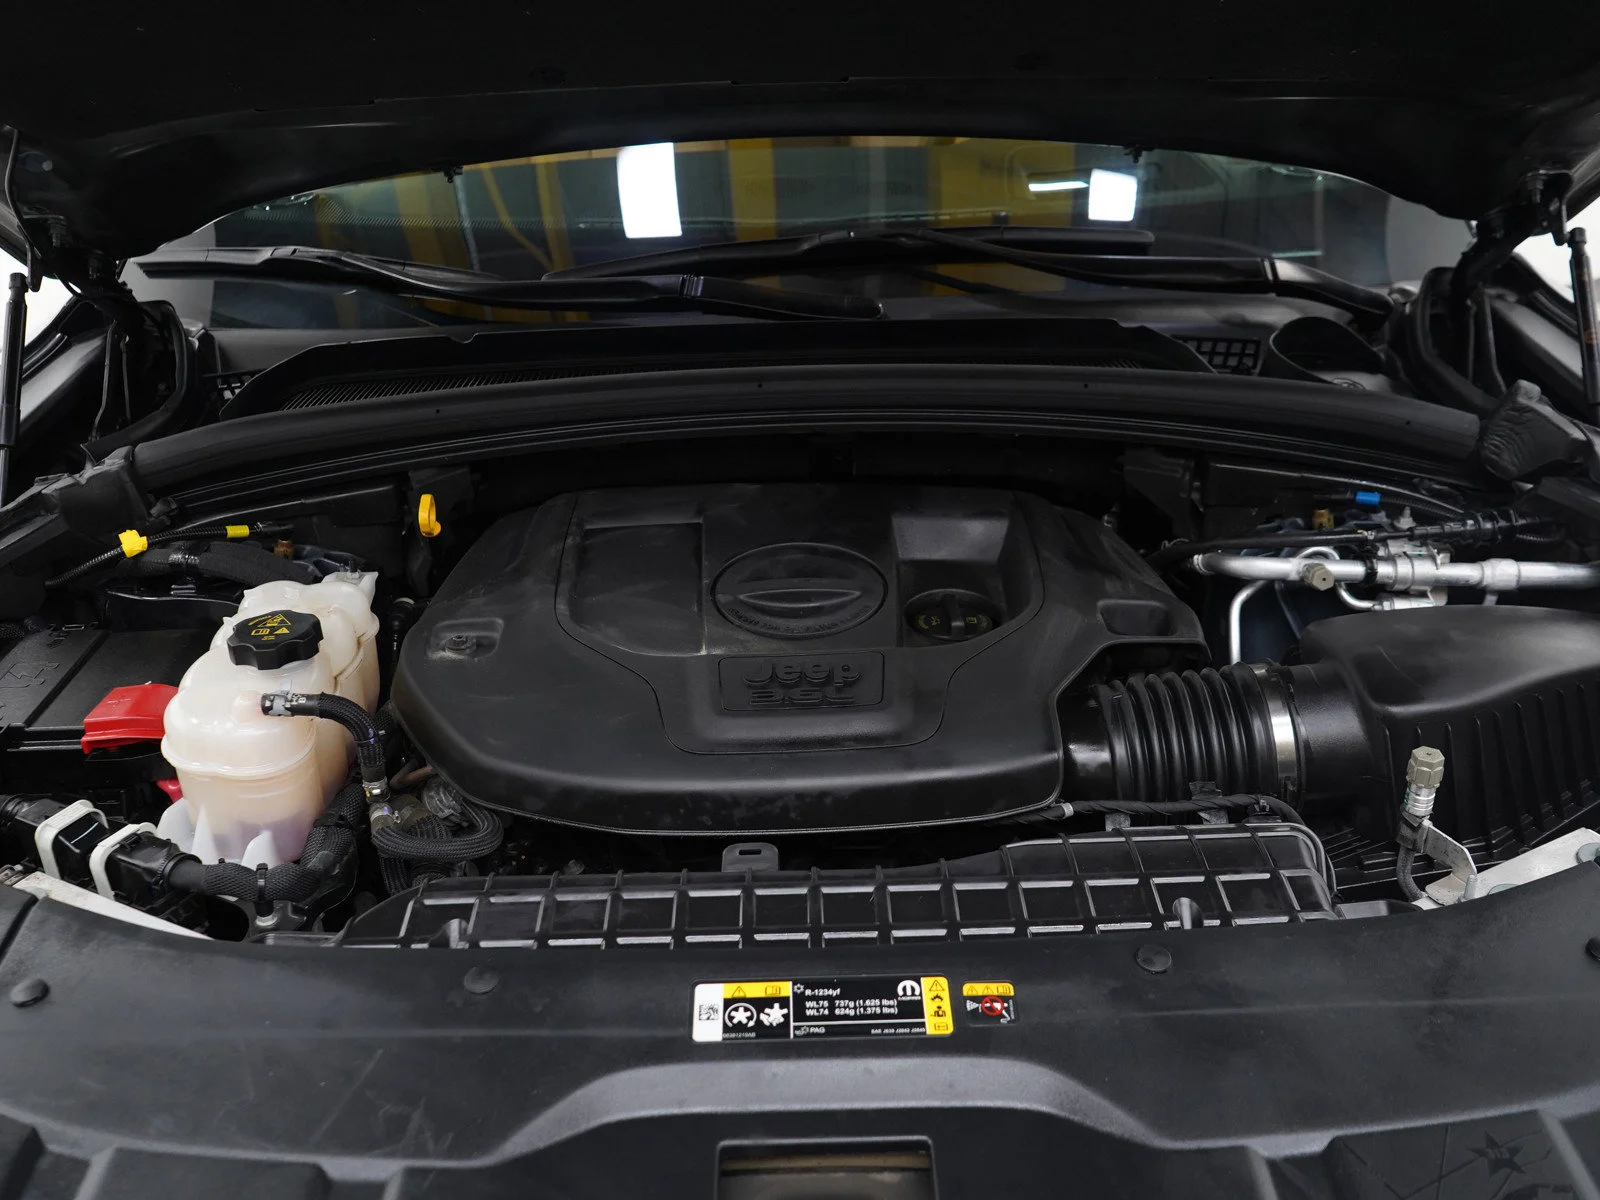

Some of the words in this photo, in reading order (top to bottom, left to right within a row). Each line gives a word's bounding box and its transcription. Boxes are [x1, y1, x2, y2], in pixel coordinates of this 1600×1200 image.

[742, 658, 864, 687] Jeep
[748, 688, 855, 706] 3.6L
[805, 988, 841, 997] R-1234yf
[805, 1000, 829, 1008] WL75
[835, 1000, 855, 1008] 737g
[856, 999, 880, 1008] (1.625
[882, 998, 897, 1007] lbs)
[805, 1008, 829, 1016] WL74
[835, 1008, 855, 1016] 624g
[856, 1007, 880, 1015] (1.375
[882, 1006, 898, 1014] lbs)
